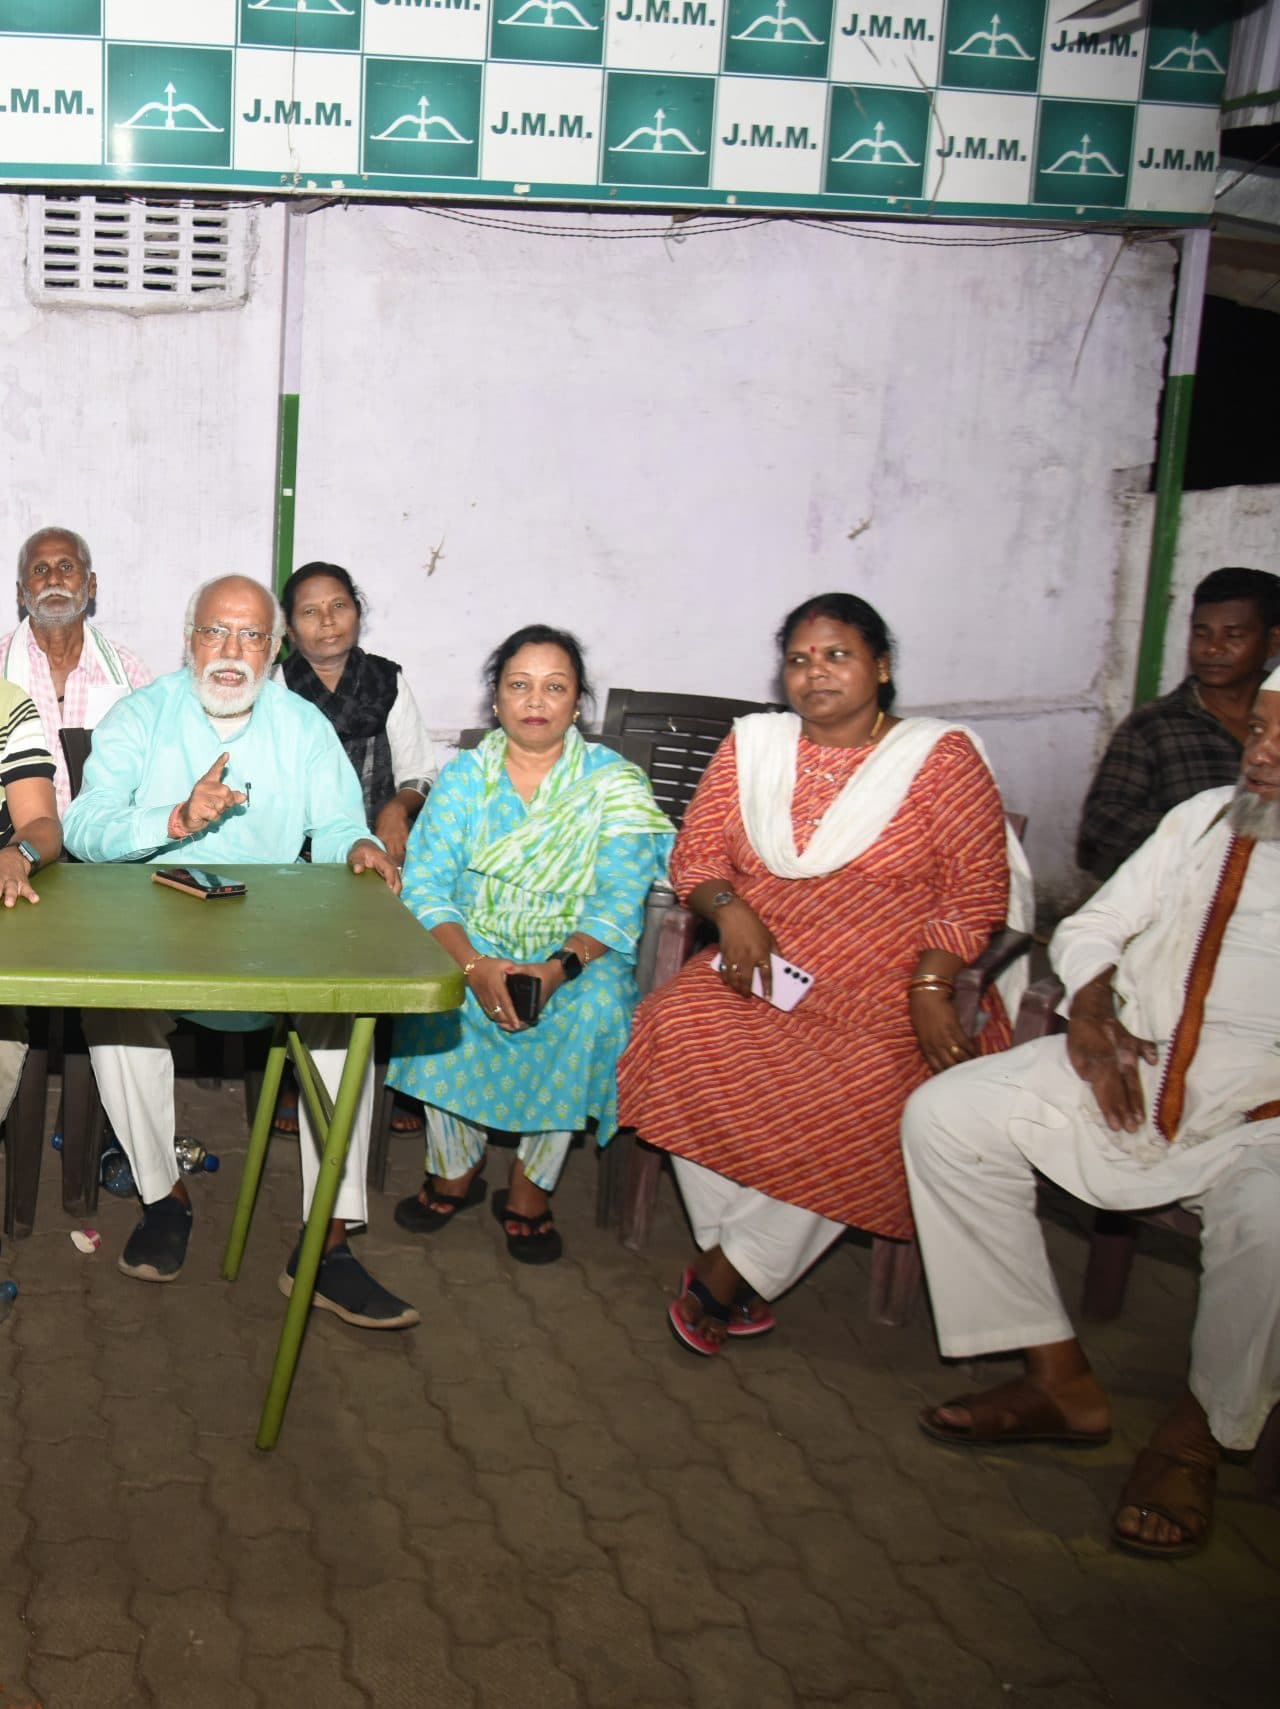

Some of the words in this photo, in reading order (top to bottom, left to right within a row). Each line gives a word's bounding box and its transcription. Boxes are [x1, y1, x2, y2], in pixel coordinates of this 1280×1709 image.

[616, 0, 715, 26] J.M.M.
[842, 14, 934, 41] J.M.M.
[1051, 30, 1138, 57] J.M.M.
[243, 99, 351, 126] J.M.M.
[491, 112, 592, 138] J.M.M.
[723, 123, 816, 150] J.M.M.
[936, 136, 1027, 162] J.M.M.
